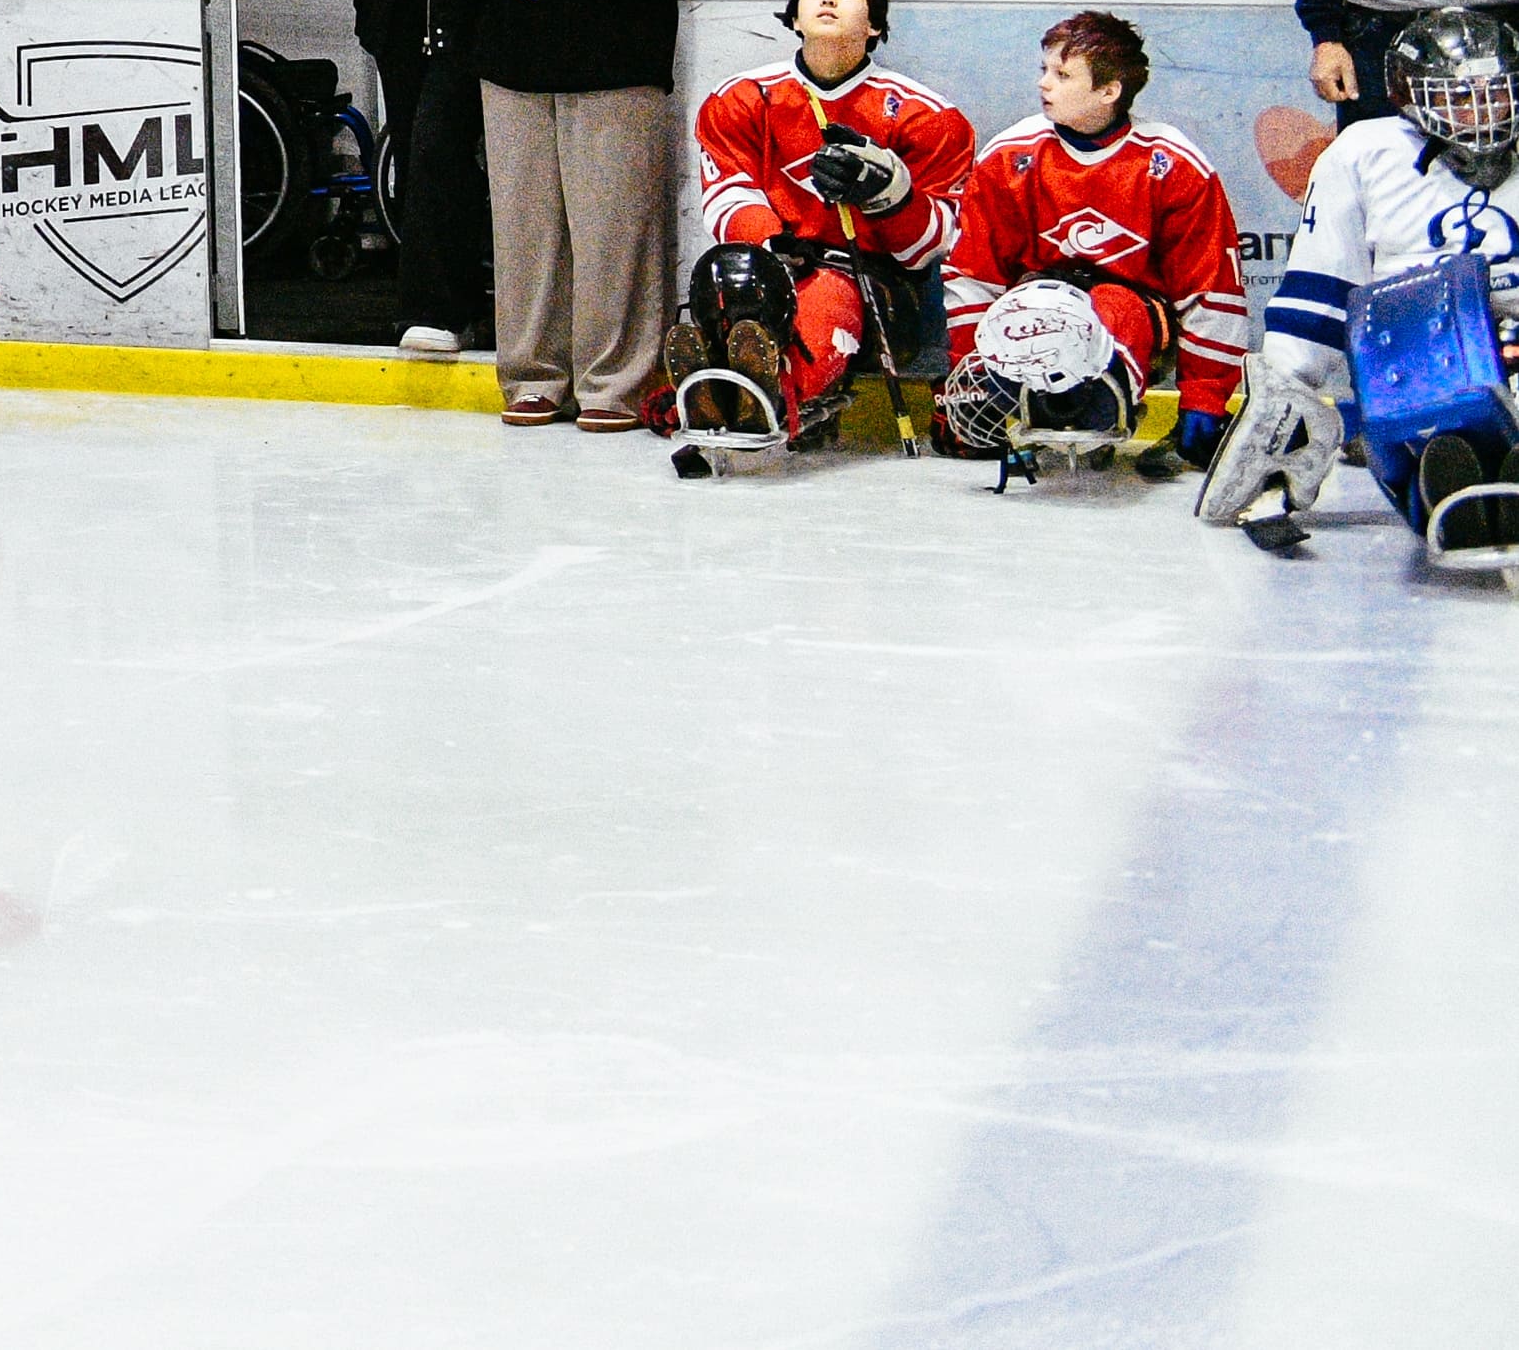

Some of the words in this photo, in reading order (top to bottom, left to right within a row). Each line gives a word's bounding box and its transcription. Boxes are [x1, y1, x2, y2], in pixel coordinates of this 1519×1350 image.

[1, 113, 204, 194] HML
[2, 195, 83, 218] HOCKEY
[89, 188, 153, 209] MEDIA
